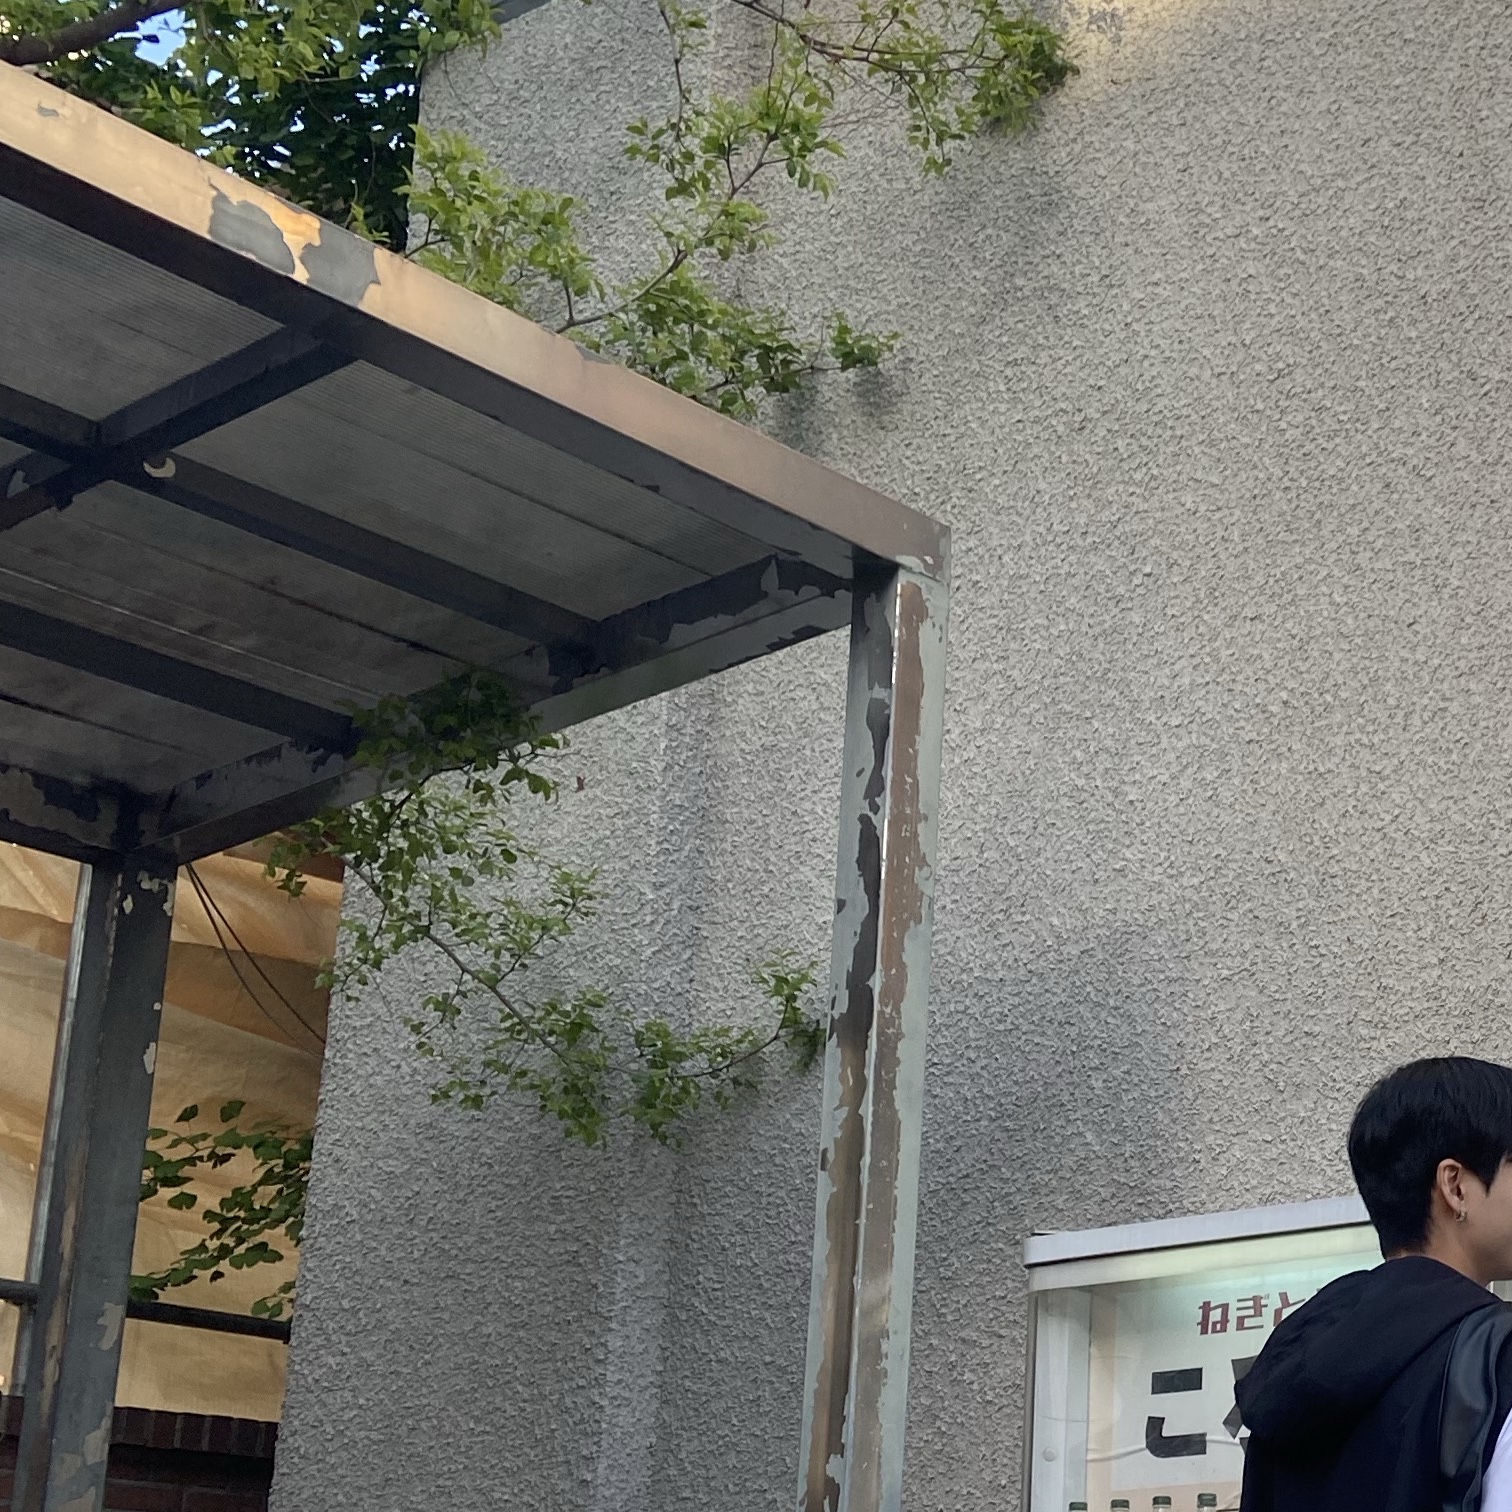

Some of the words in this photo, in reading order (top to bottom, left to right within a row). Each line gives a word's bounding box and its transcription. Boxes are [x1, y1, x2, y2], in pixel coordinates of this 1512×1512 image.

[1197, 1288, 1321, 1335] ねぎと
[1146, 1355, 1258, 1458] こ
